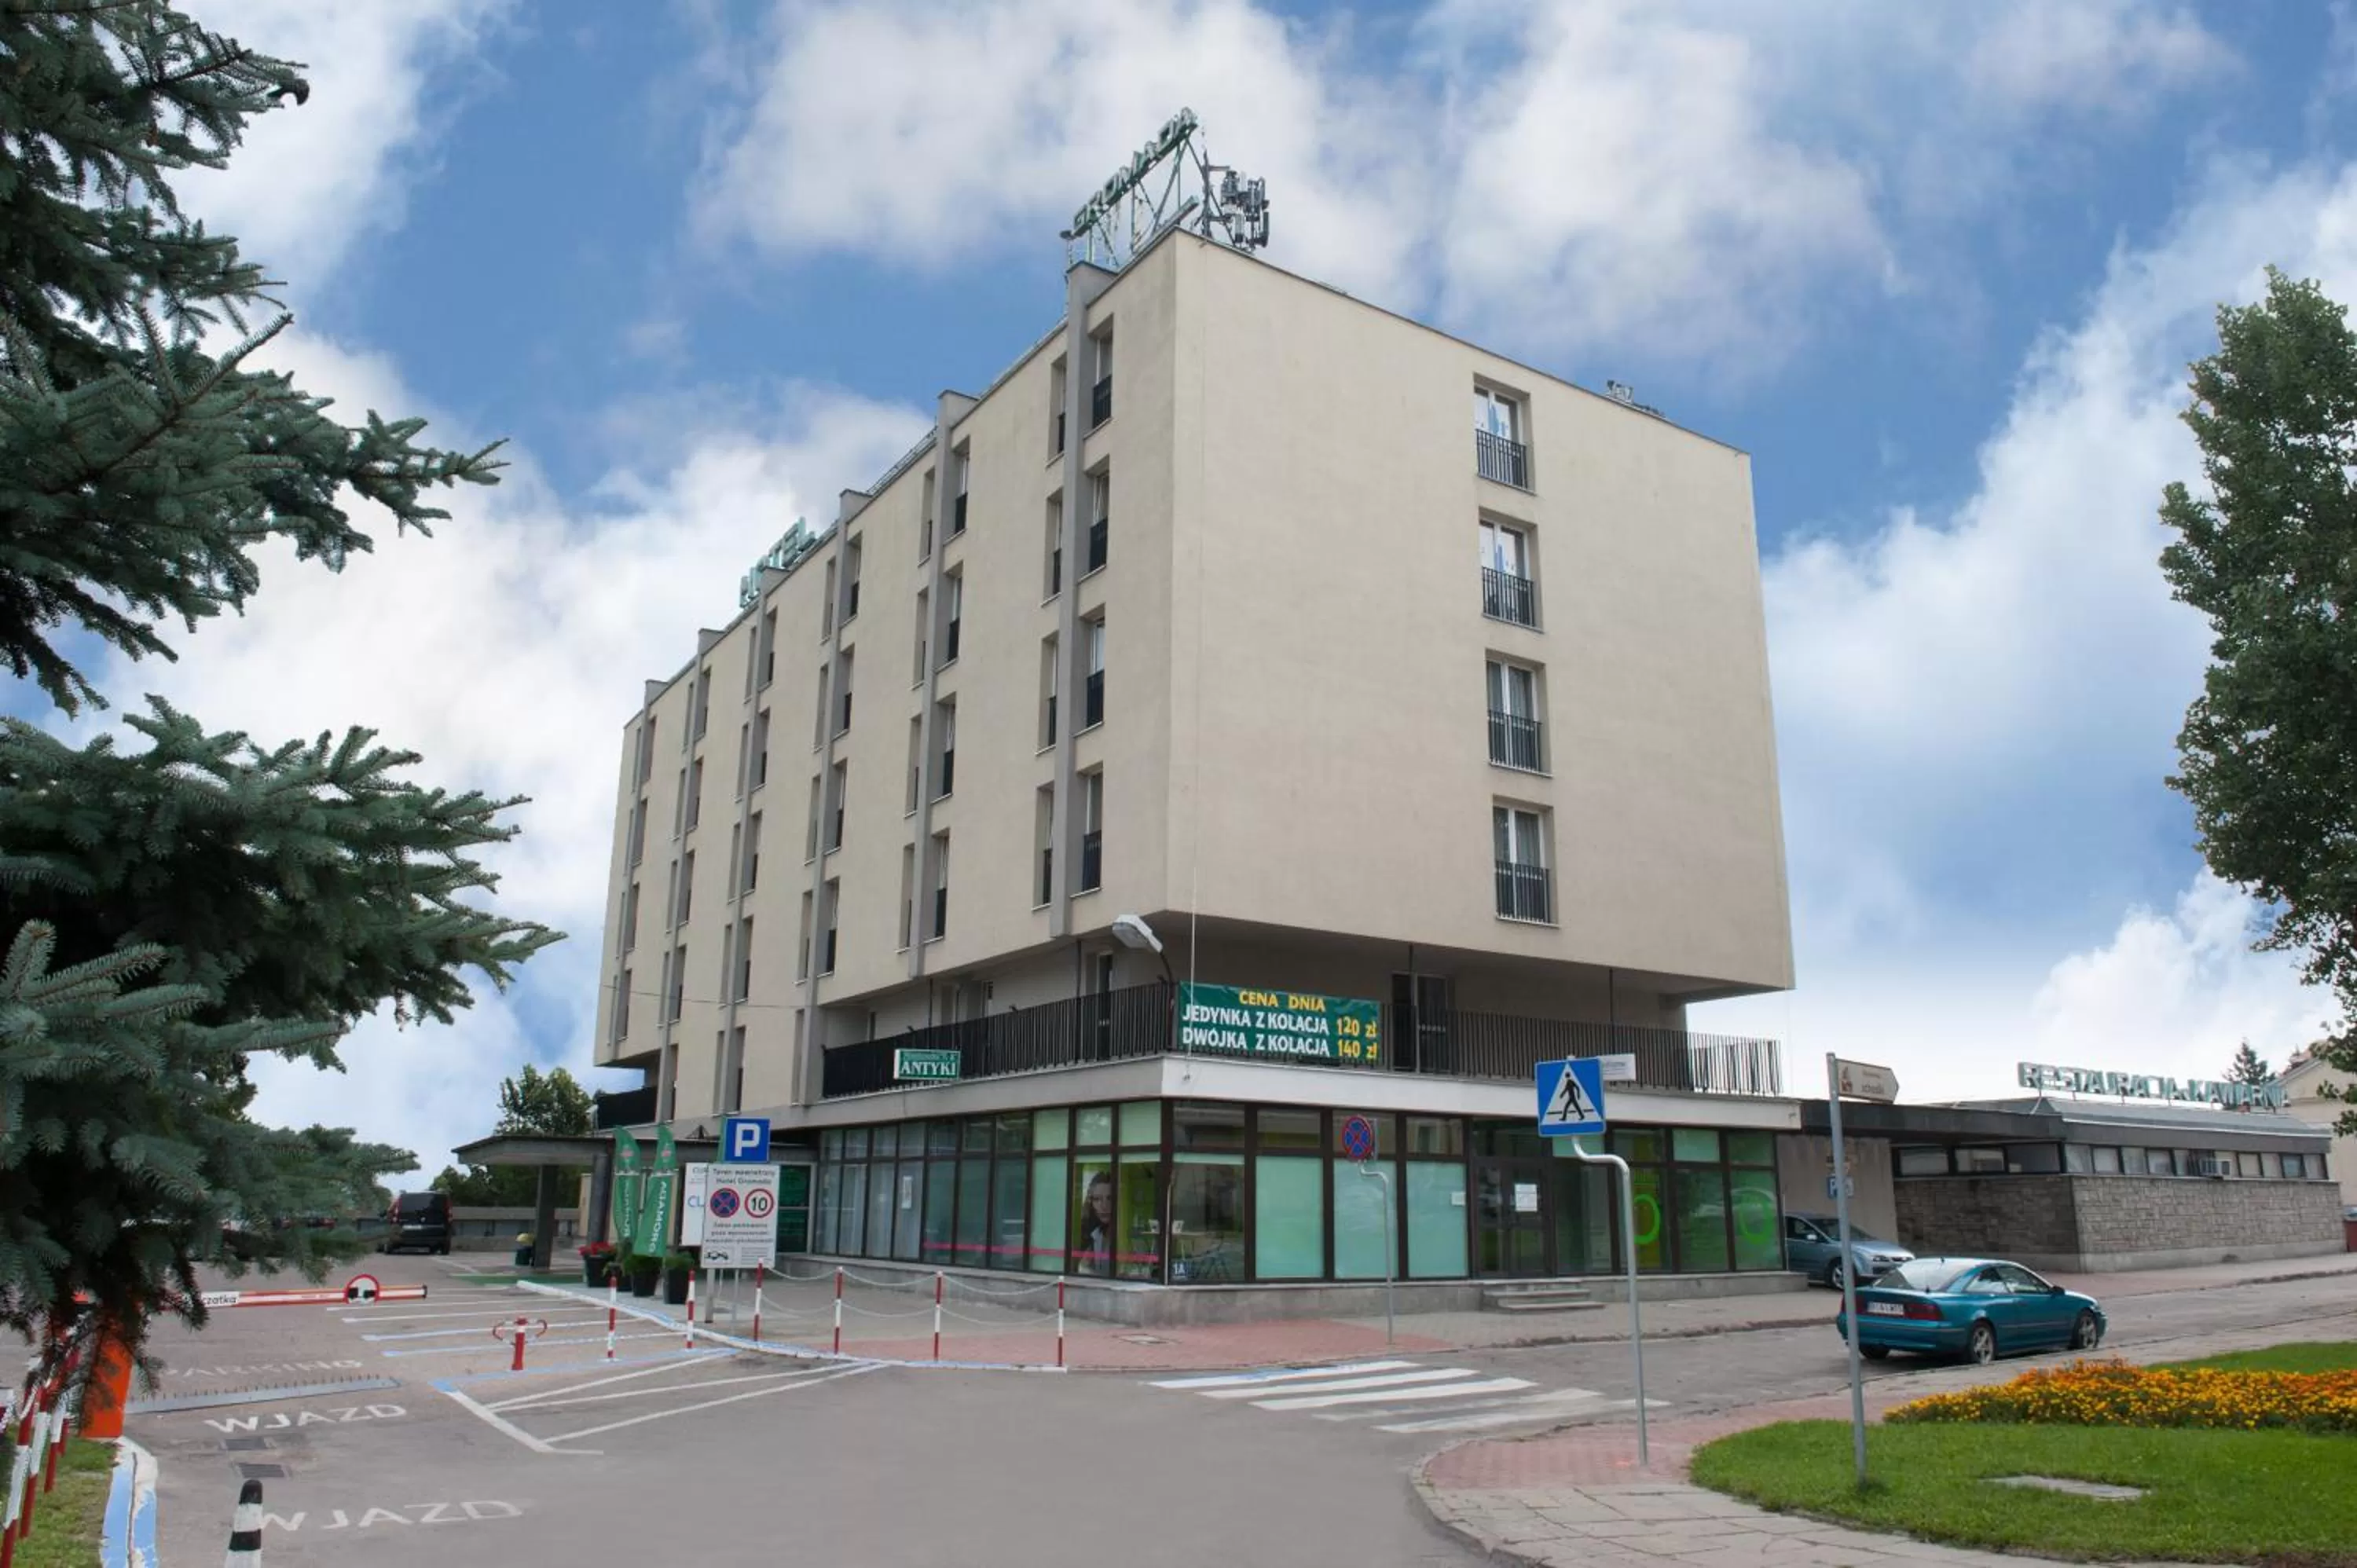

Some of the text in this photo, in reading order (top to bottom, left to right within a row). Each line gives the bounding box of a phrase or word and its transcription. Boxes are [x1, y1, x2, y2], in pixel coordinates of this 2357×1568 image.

[1239, 991, 1326, 1012] CENA DNIA
[1182, 1004, 1251, 1028] JEDYNKA
[1255, 1012, 1266, 1028] Z
[1336, 1016, 1360, 1036] 120
[1255, 1033, 1266, 1050] Z
[1337, 1039, 1361, 1058] 140
[900, 1061, 955, 1075] ANTYKI
[735, 1123, 761, 1157] P
[751, 1196, 768, 1211] 10
[203, 1403, 408, 1433] WJAZD
[260, 1500, 523, 1532] WJAZD
